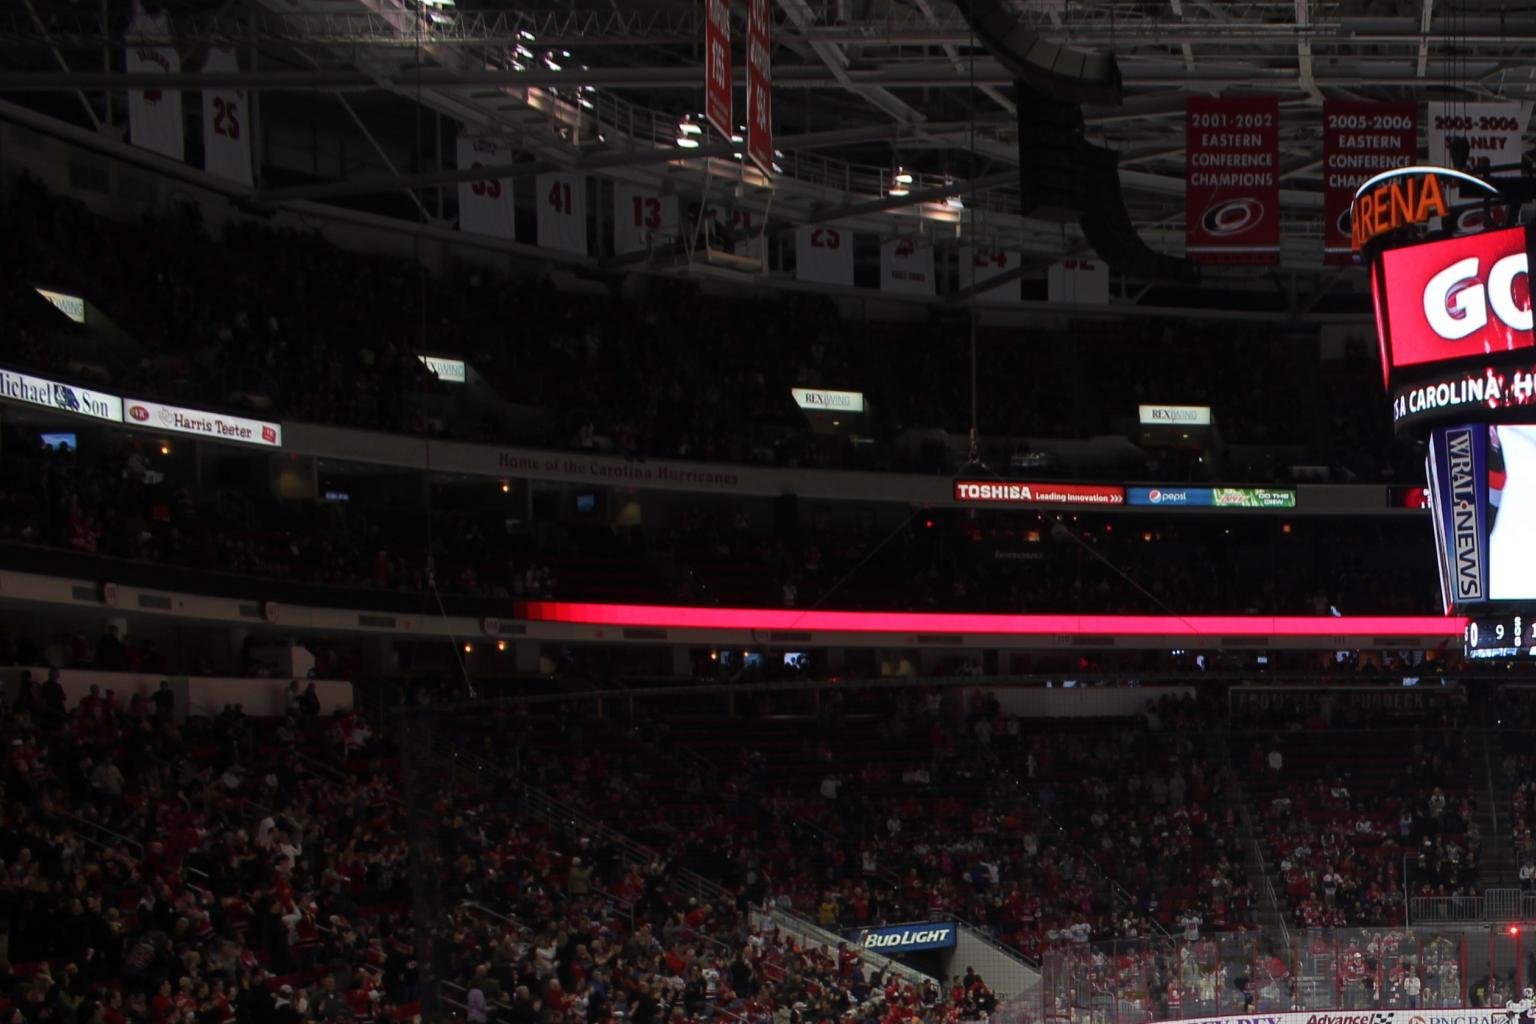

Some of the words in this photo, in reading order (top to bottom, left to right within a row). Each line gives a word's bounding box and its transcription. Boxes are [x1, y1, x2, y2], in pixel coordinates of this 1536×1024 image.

[213, 96, 240, 138] 25
[1192, 113, 1272, 127] 2001-2002
[1328, 115, 1411, 129] 2005-2006
[1434, 115, 1518, 130] 2005-2006
[1202, 133, 1262, 147] EASTERN
[1338, 135, 1401, 148] EASTERN
[1444, 136, 1506, 150] SNLEY
[1191, 152, 1272, 167] CONFERENCE
[1328, 154, 1410, 168] CONFERENCE
[1190, 172, 1273, 186] CHAMPIONS
[549, 180, 571, 215] 41
[632, 195, 661, 228] 13
[1352, 173, 1448, 250] ARENA
[82, 389, 110, 417] Son
[805, 392, 824, 404] REX
[1408, 376, 1502, 414] CAROLINA
[1152, 408, 1171, 420] REX
[173, 411, 212, 432] Harris
[214, 420, 252, 440] Teeter
[500, 453, 539, 470] Home
[544, 460, 559, 472] of
[562, 461, 585, 474] the
[590, 463, 652, 479] Carolina
[657, 466, 738, 485] Hurricanes
[1449, 431, 1474, 507] WRAL
[958, 484, 1032, 500] TOSHIBA
[1035, 493, 1065, 503] Leading
[1067, 492, 1108, 503] Innovation
[1162, 492, 1186, 505] pepsi
[1456, 509, 1478, 596] NEWS
[1494, 622, 1505, 640] 9
[864, 933, 901, 948] BUD
[901, 929, 950, 945] LIGHT
